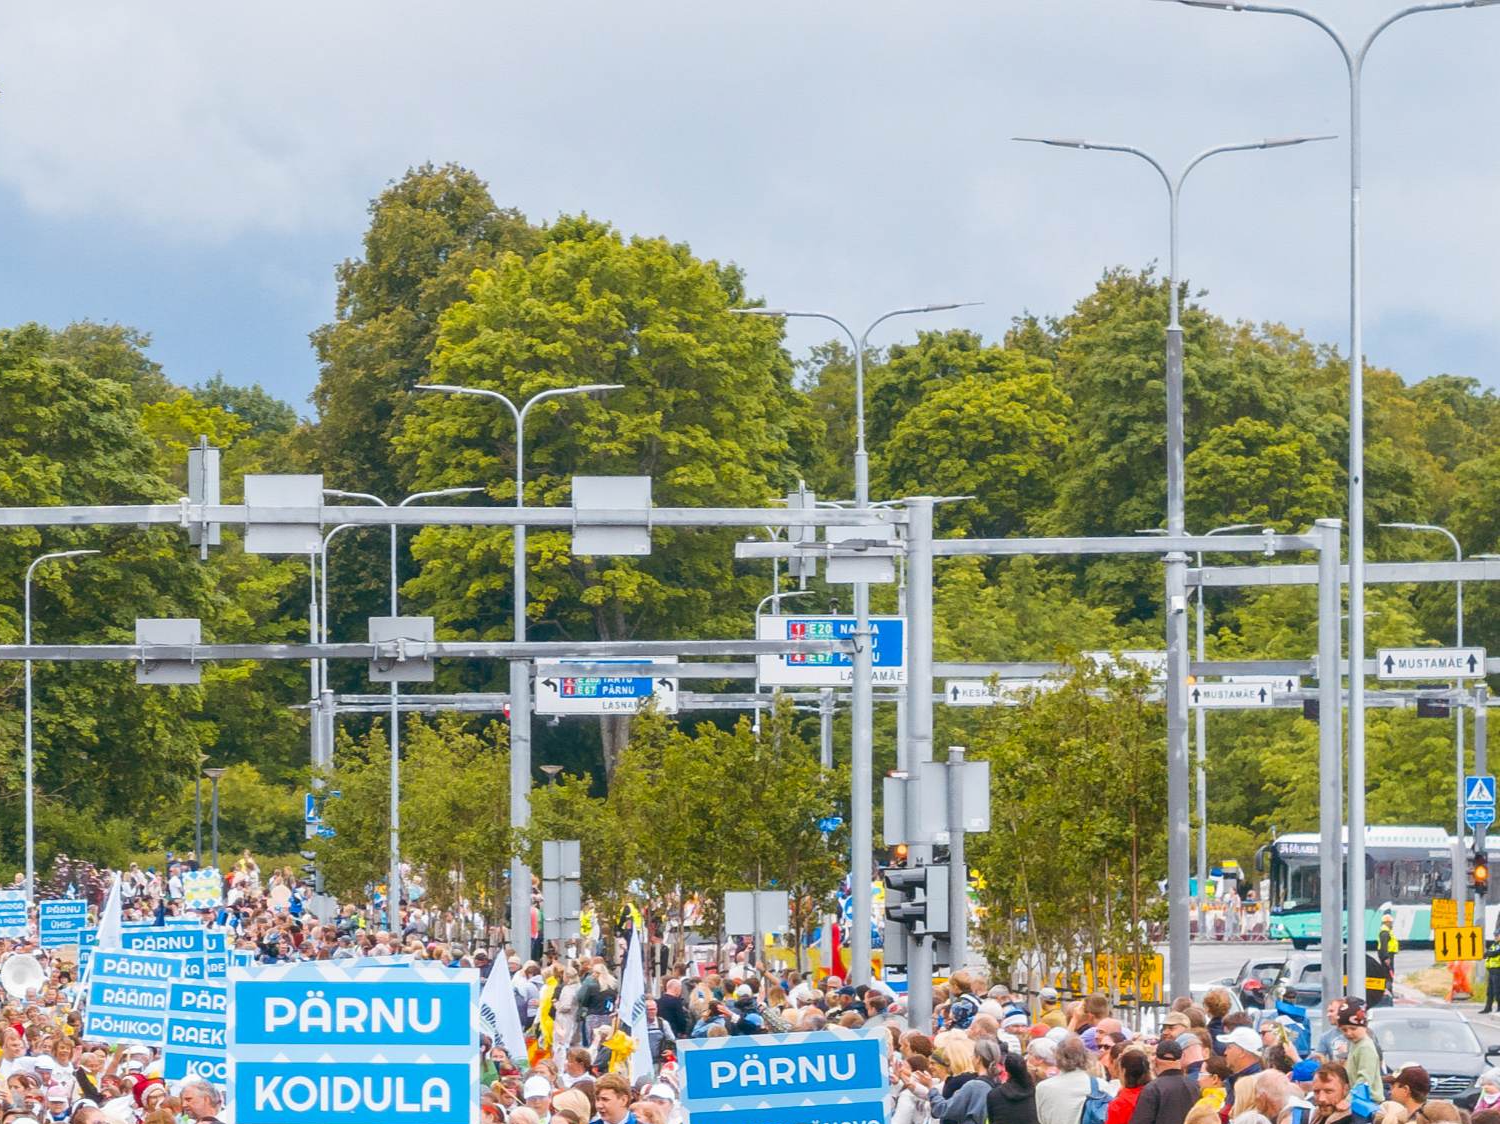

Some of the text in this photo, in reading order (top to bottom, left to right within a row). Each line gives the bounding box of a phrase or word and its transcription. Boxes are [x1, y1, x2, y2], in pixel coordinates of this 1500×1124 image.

[795, 623, 879, 634] 1 E 20 NAVA
[840, 670, 903, 680] LAAMÄE
[566, 684, 635, 694] 4 E 67 PÄRNU
[1203, 689, 1256, 699] MUSTAMÄE
[602, 701, 638, 710] LASNA
[131, 935, 194, 951] PÄRNU
[103, 957, 172, 978] PÄRNU
[102, 986, 165, 1009] RÄÄMA
[181, 991, 227, 1011] PÄR
[264, 990, 442, 1034] PÄRNU
[91, 1016, 162, 1036] PÕHIKOO
[171, 1025, 227, 1045] RAEK
[186, 1060, 227, 1079] KOO
[710, 1053, 856, 1089] PÄRNU
[254, 1076, 451, 1113] KOIDULA
